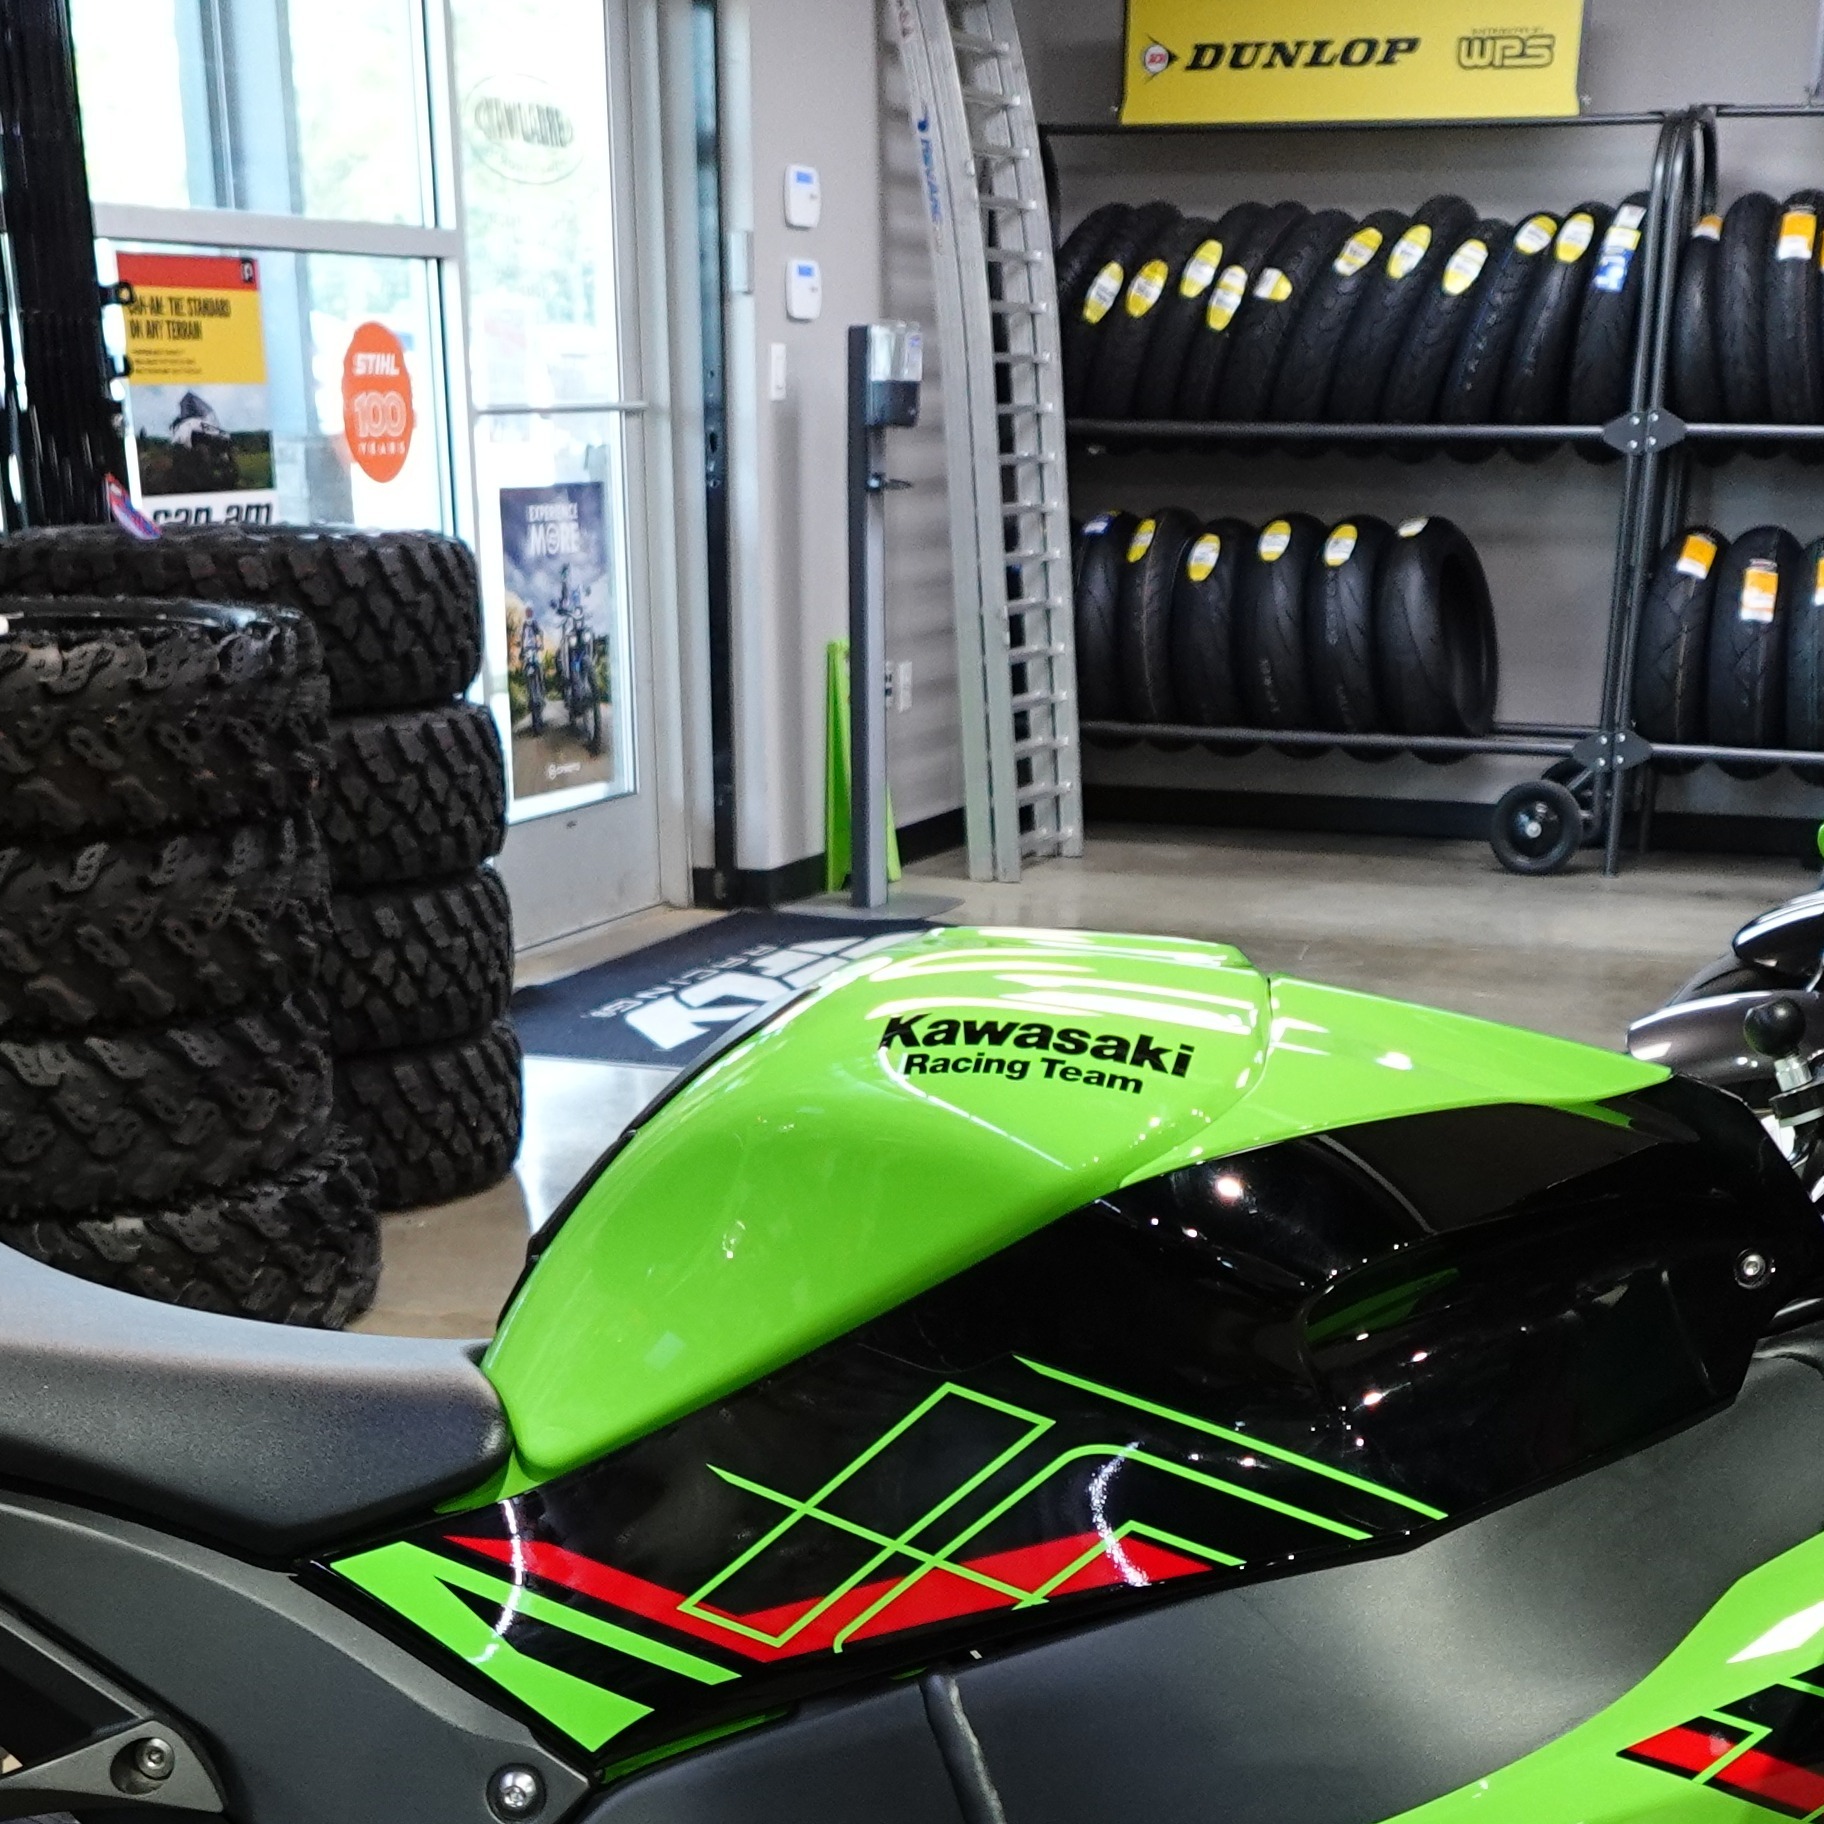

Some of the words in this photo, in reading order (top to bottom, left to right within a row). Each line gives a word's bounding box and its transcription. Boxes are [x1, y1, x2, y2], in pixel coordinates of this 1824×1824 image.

[1185, 37, 1421, 71] DUNLOP
[1457, 35, 1555, 69] WPS
[352, 352, 401, 377] STIHL
[354, 389, 408, 438] 100
[877, 1012, 1196, 1079] Kawasaki
[902, 1051, 1032, 1081] Racing
[1040, 1056, 1144, 1095] Team
